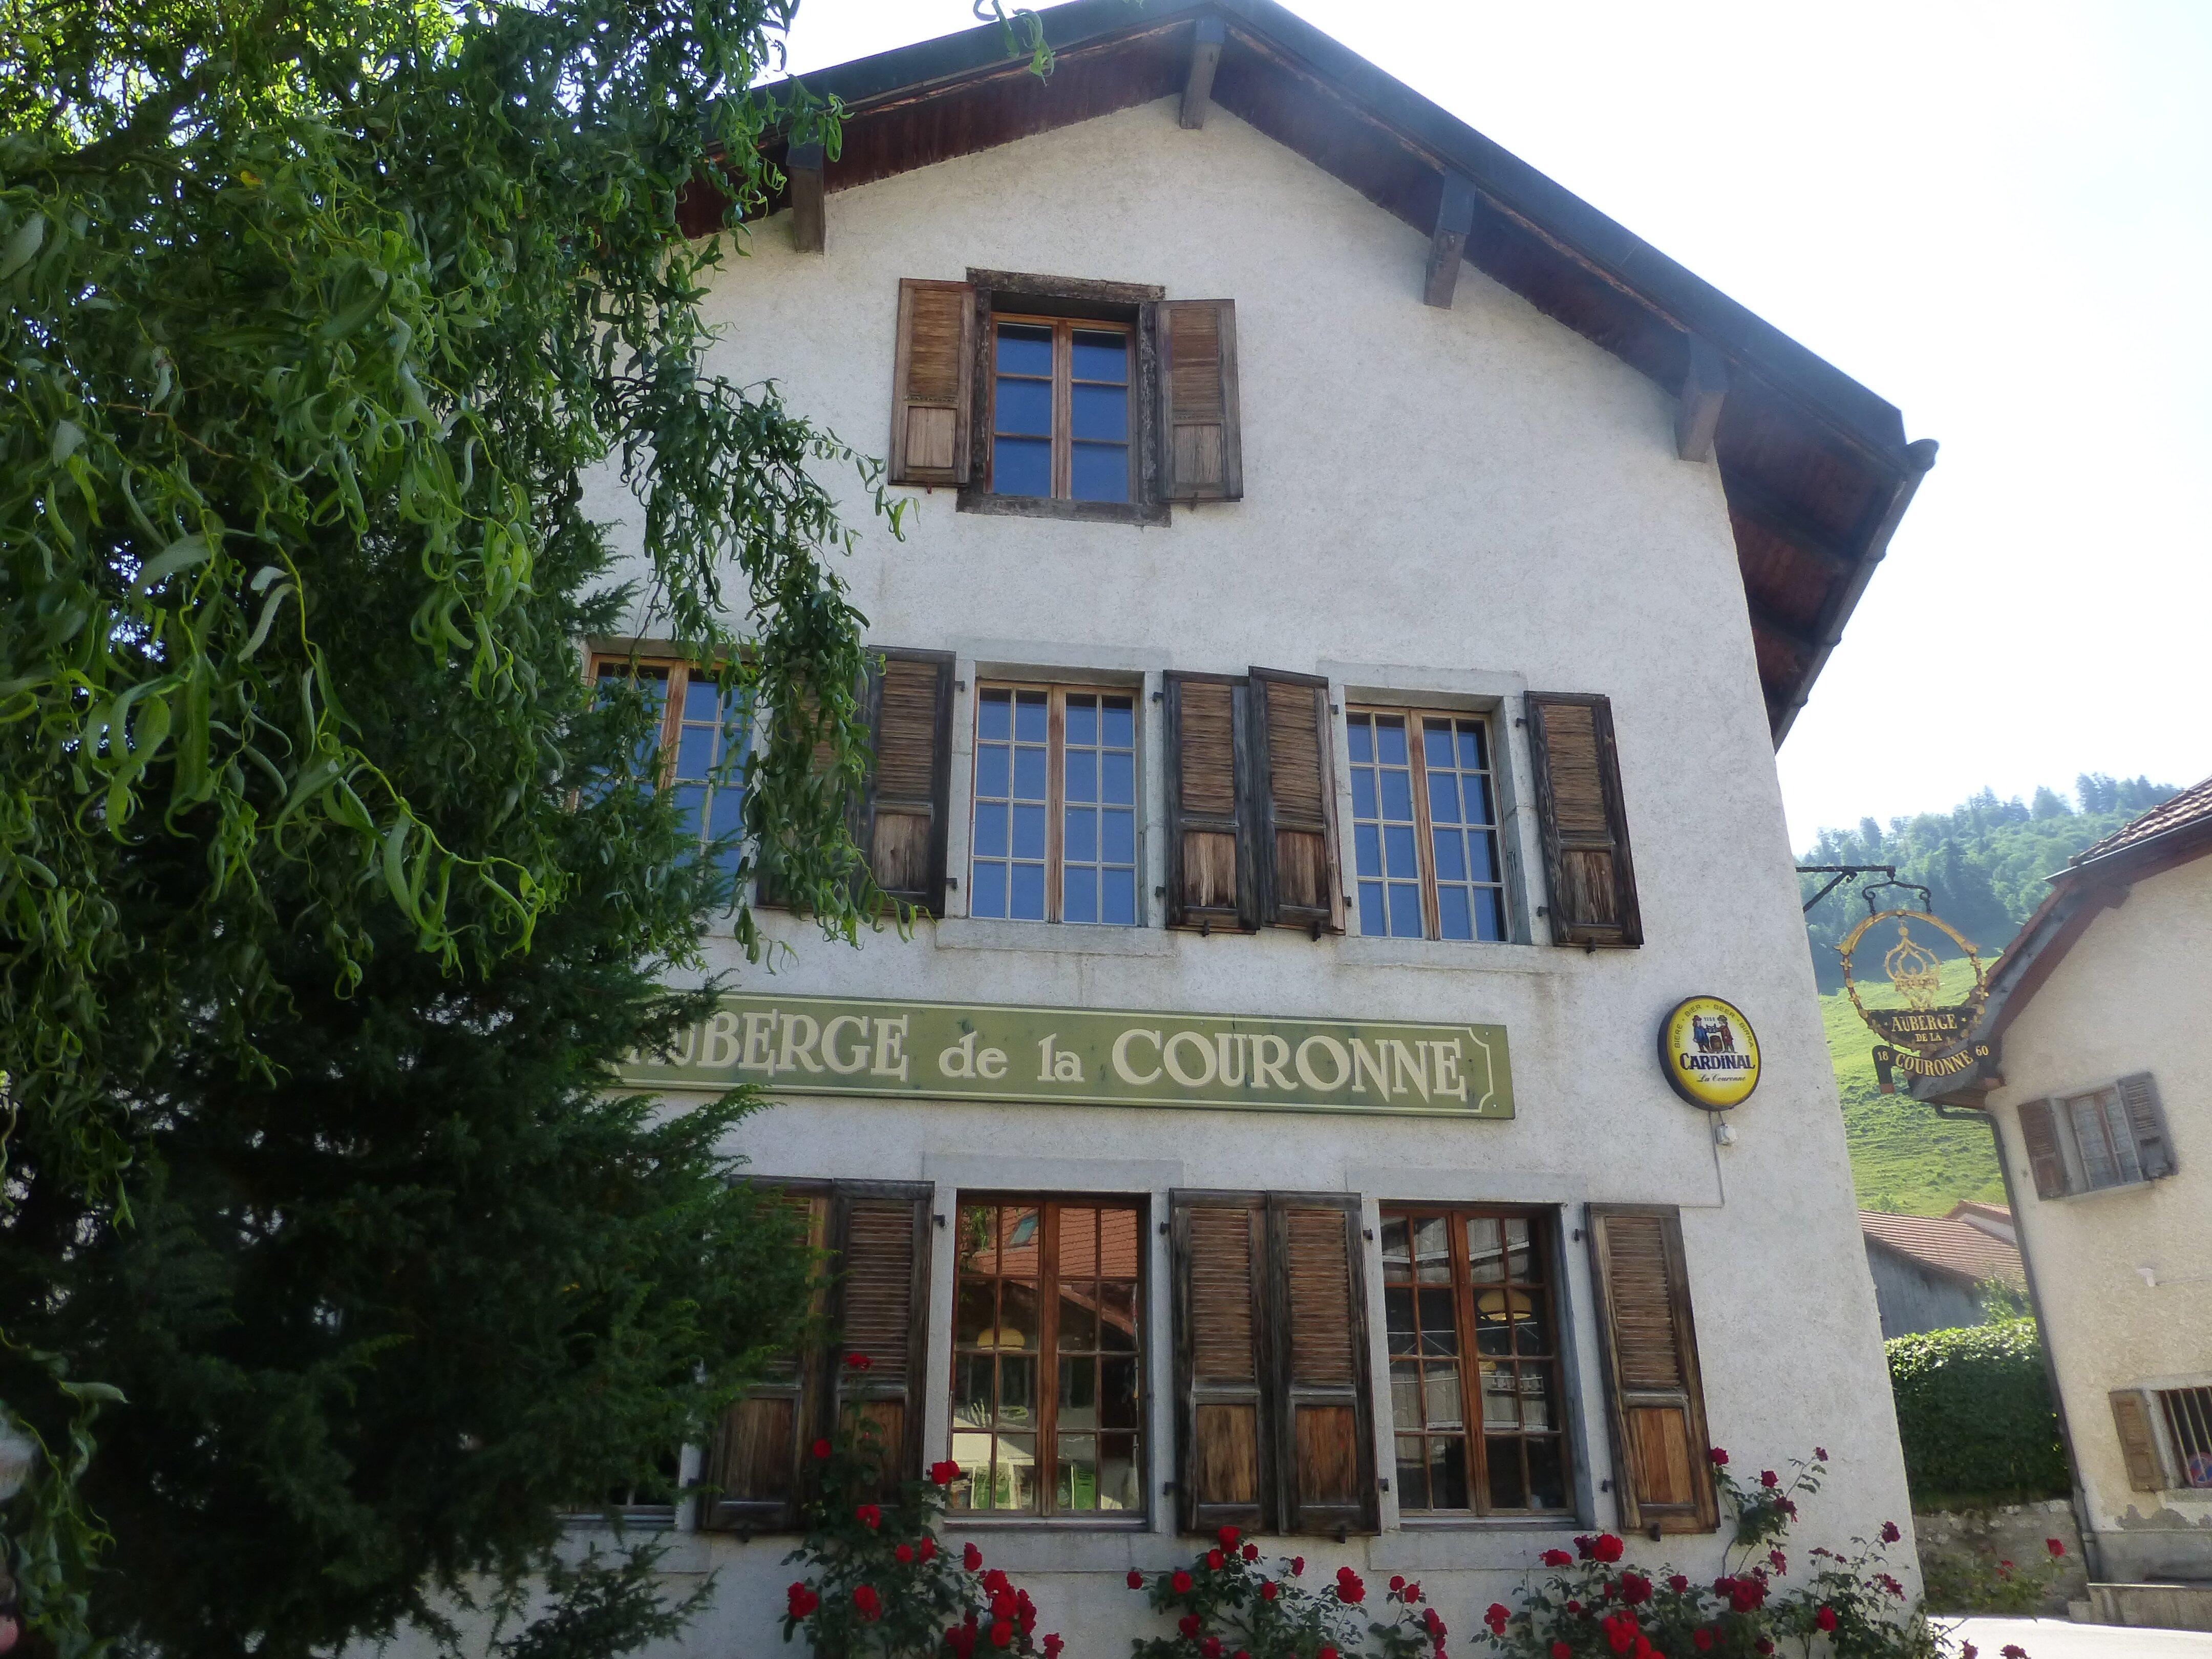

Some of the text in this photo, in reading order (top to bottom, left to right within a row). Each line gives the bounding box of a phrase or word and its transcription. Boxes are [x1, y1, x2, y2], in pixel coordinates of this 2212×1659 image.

[1685, 1005, 1701, 1017] BIER
[1714, 1004, 1735, 1018] BEER
[1739, 1023, 1753, 1048] BIRRA
[1891, 1014, 1957, 1032] AUBERGE
[1930, 1033, 1942, 1041] LA
[625, 1008, 1467, 1102] UBERGE de la COURONNE
[1878, 1045, 1989, 1076] 18 COURONNE 60
